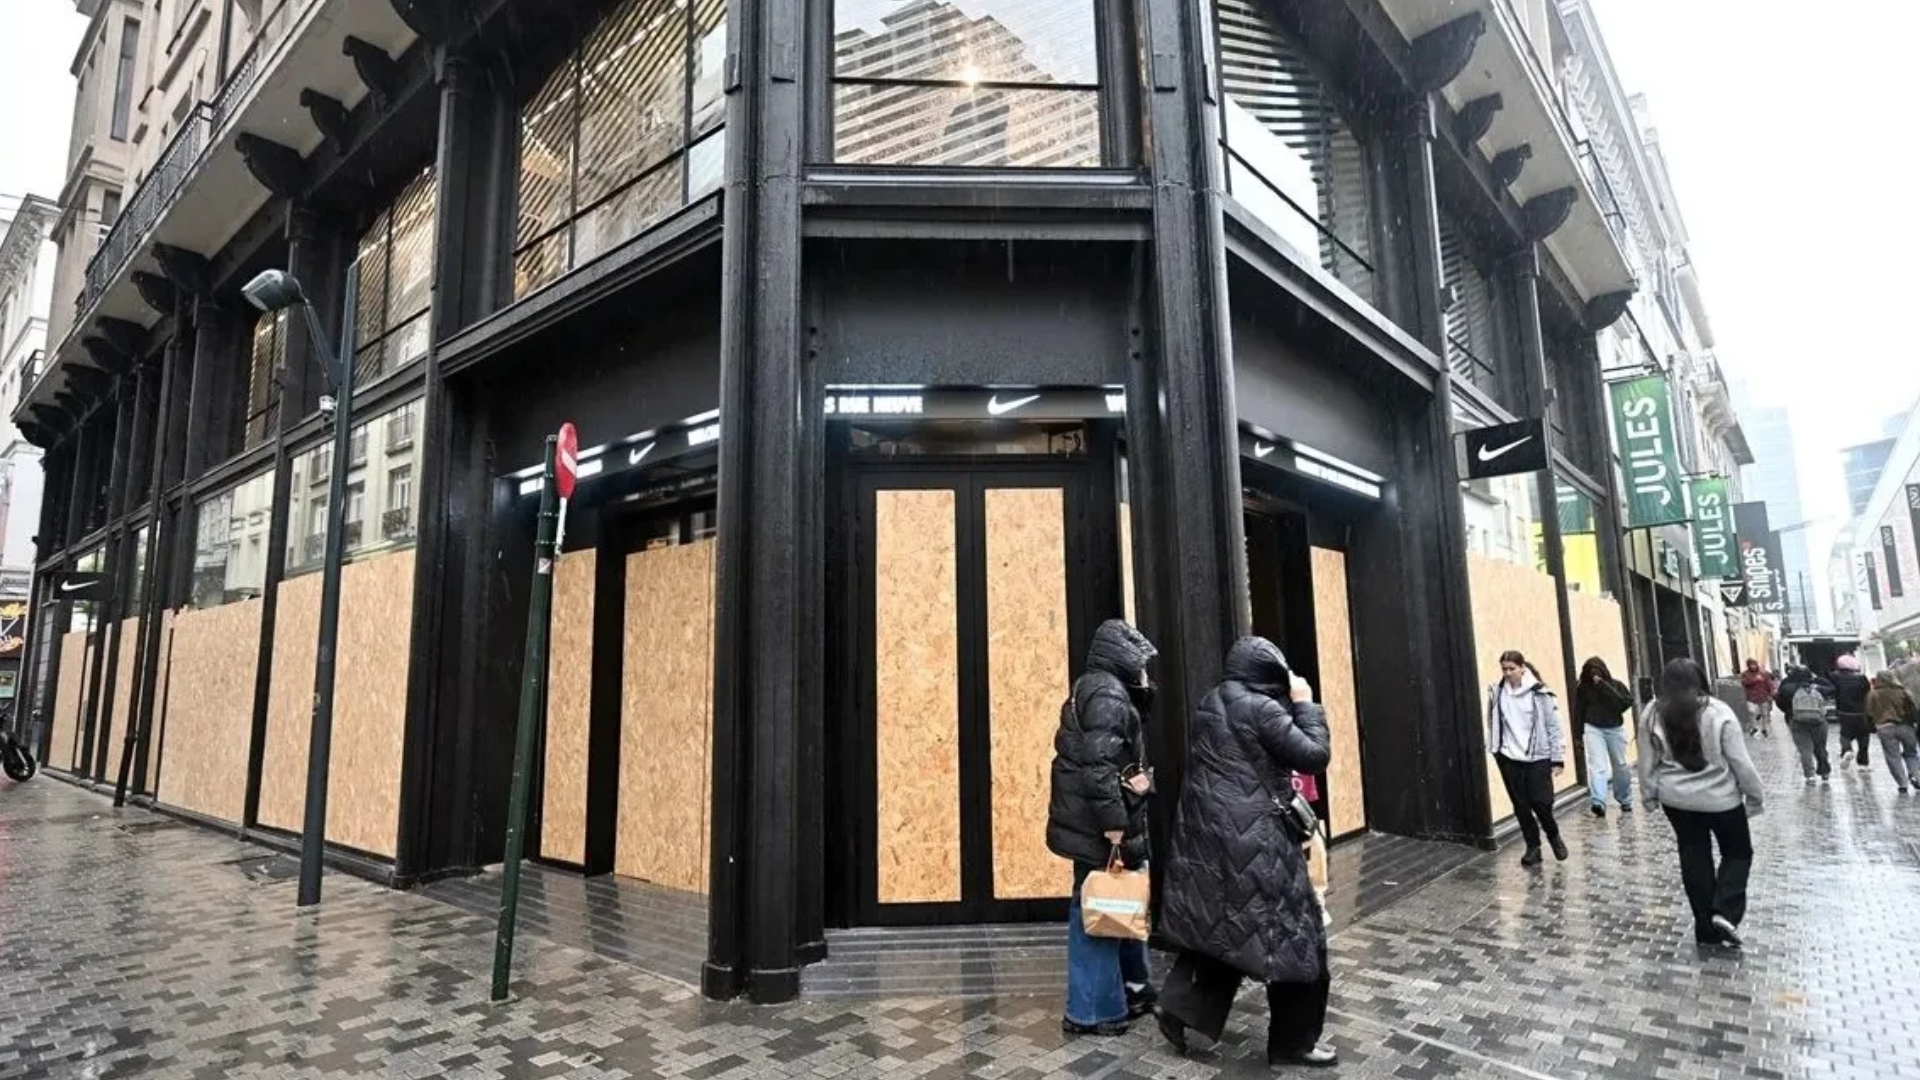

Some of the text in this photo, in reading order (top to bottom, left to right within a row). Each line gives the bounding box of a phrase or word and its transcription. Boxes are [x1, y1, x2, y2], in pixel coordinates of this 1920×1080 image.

[1623, 397, 1671, 506] JULES
[1697, 491, 1729, 565] JULES
[1743, 547, 1773, 598] snipes
